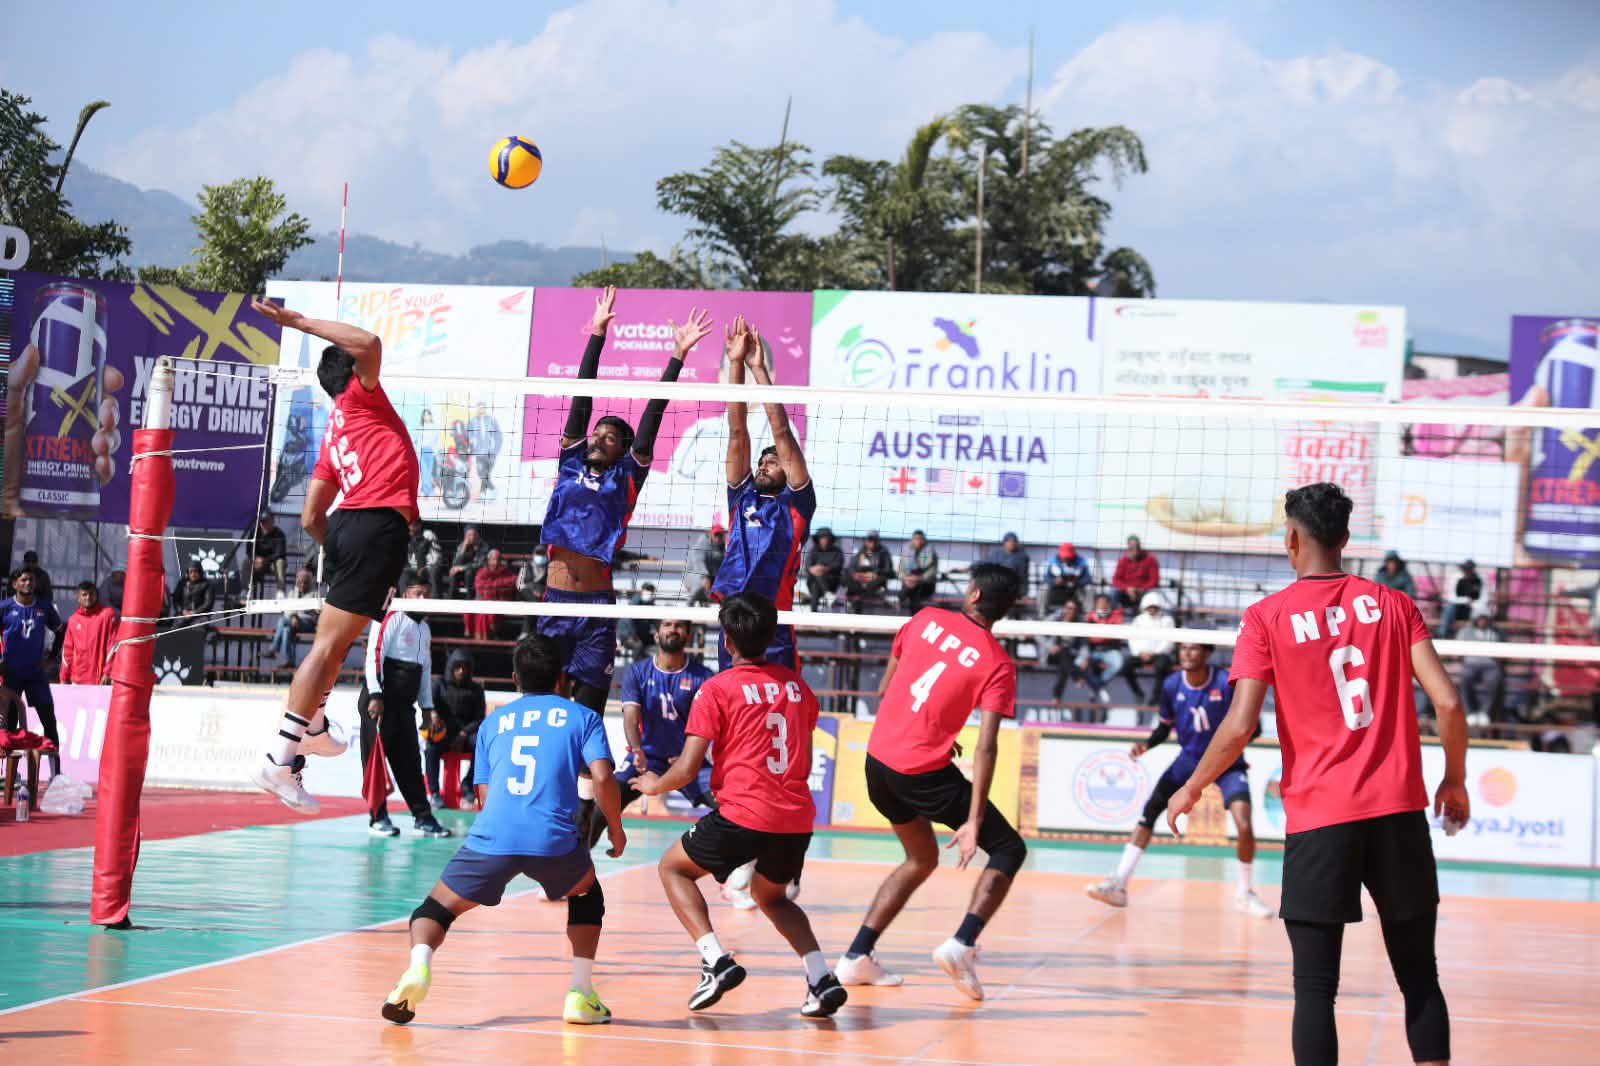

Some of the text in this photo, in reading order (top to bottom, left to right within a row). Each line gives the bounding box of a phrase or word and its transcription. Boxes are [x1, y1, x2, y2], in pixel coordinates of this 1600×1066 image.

[340, 287, 403, 320] RIDE
[131, 355, 268, 409] XREME
[906, 349, 1077, 393] Franklin
[130, 399, 265, 435] ERGY DRINK
[868, 430, 1048, 464] AUSTRALIA
[38, 491, 69, 502] CLASSIC
[1290, 594, 1382, 644] NPC
[921, 621, 980, 668] NPC
[742, 680, 802, 705] NPC
[910, 661, 947, 713] 4
[1329, 644, 1374, 731] 6
[499, 707, 567, 735] NPC
[765, 712, 789, 774] 3
[507, 735, 540, 795] 5
